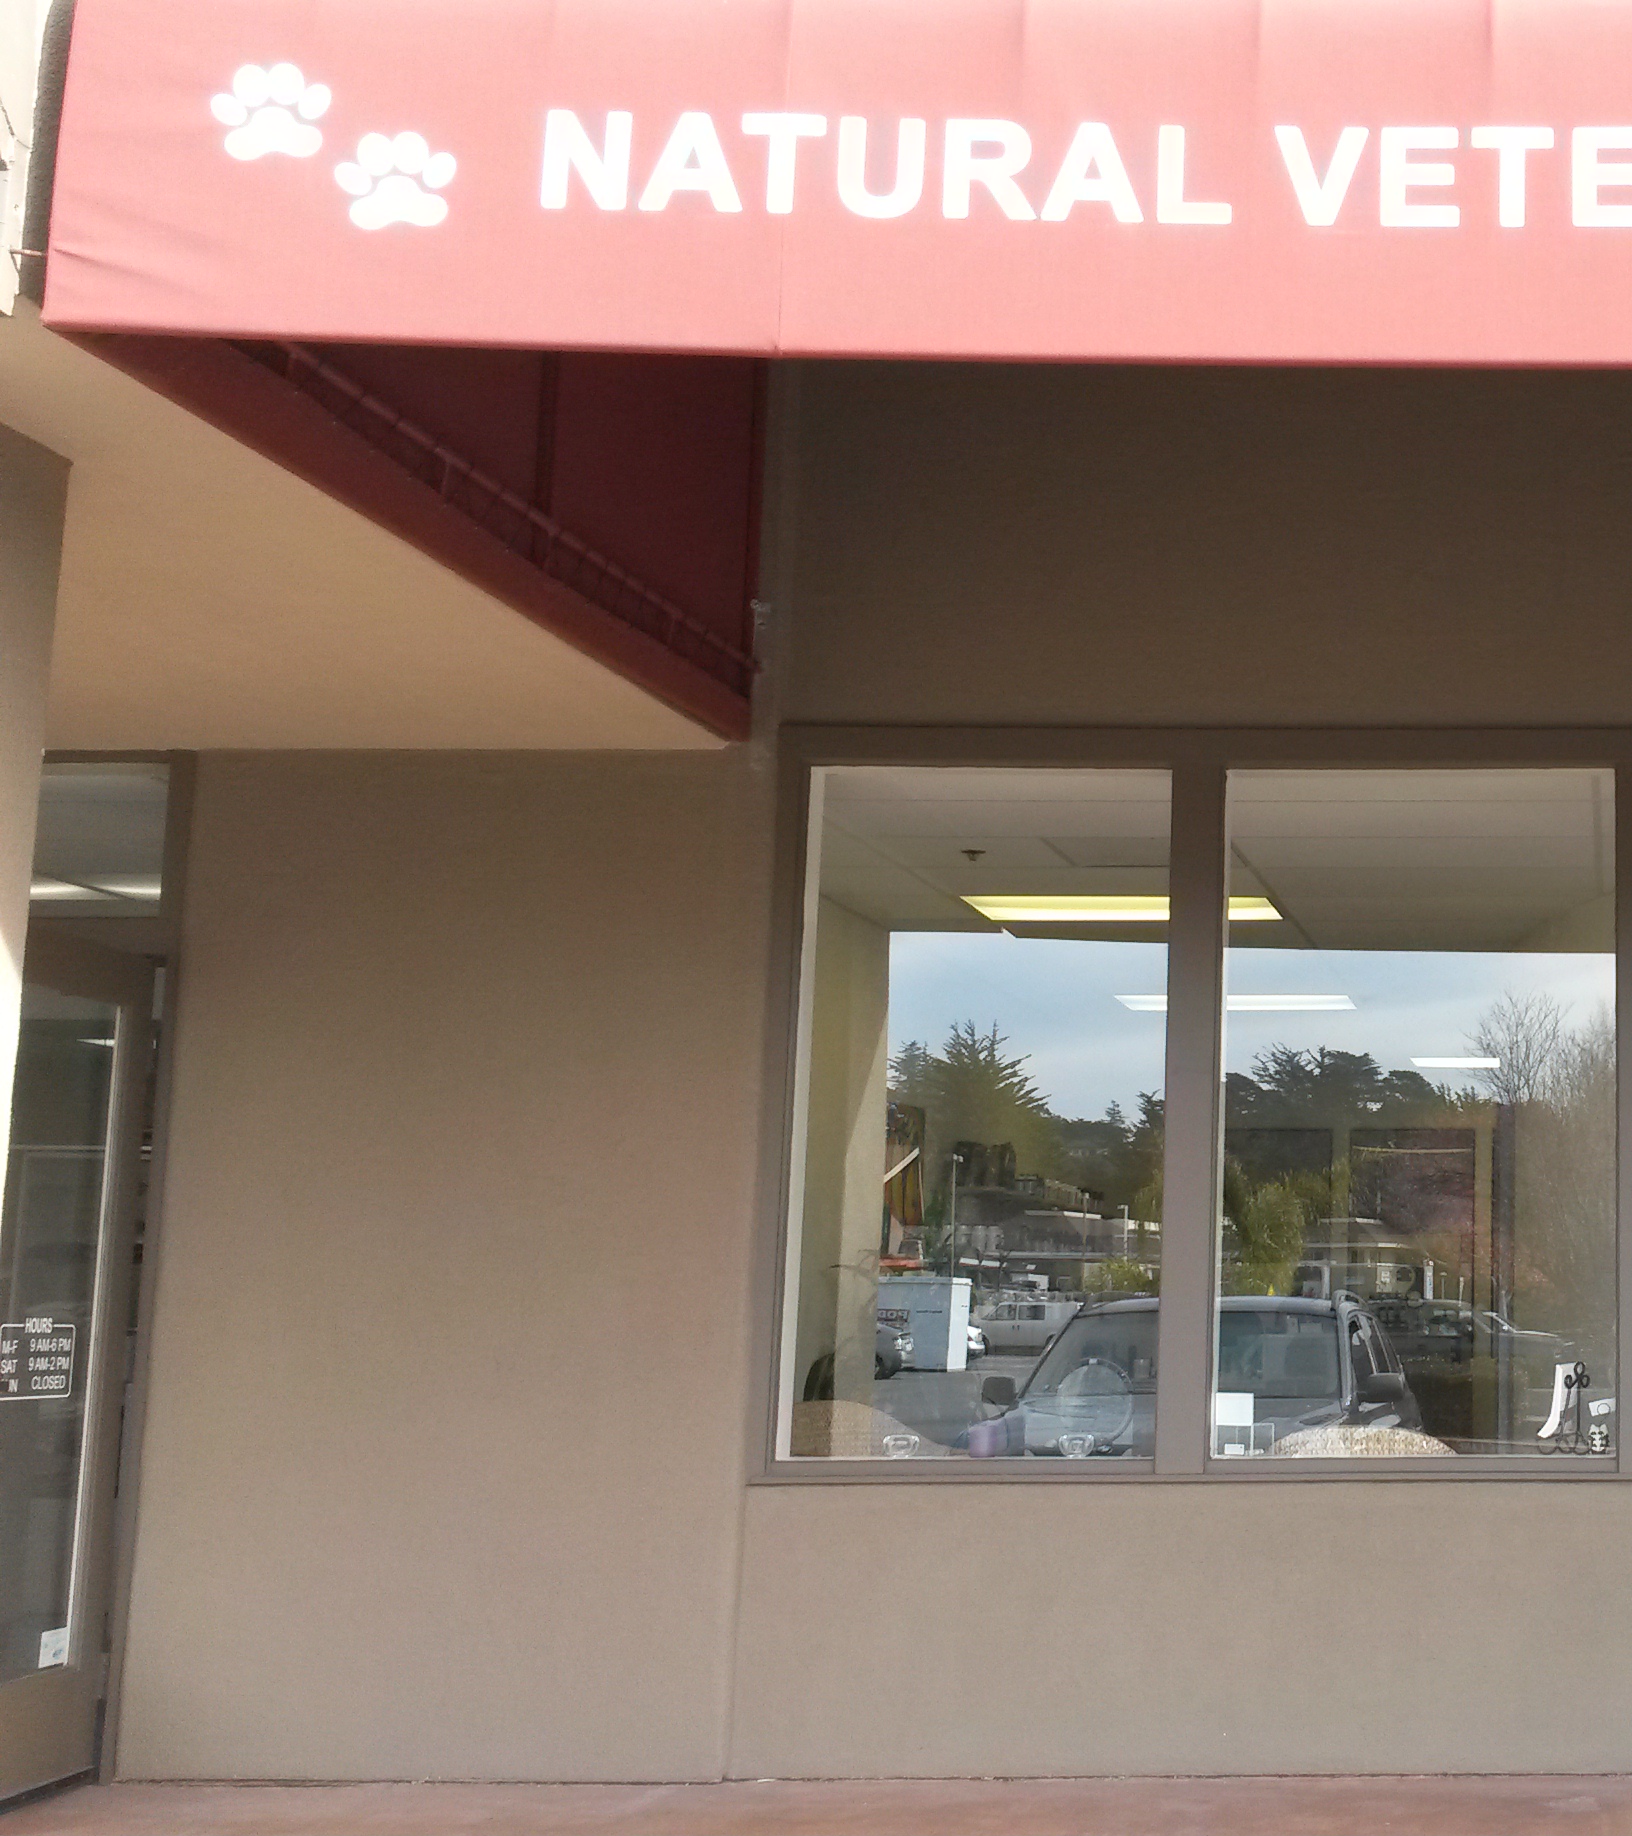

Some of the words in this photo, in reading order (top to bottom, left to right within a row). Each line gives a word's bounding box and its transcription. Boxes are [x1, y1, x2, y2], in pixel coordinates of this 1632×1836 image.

[539, 107, 1233, 226] NATURAL
[25, 1317, 53, 1334] HOURS
[2, 1339, 19, 1354] M-F
[29, 1338, 36, 1352] 9
[58, 1338, 72, 1352] PM
[0, 1359, 18, 1374] SAT
[28, 1356, 35, 1371] 9
[56, 1356, 70, 1370] PM
[31, 1375, 66, 1390] CLOSED
